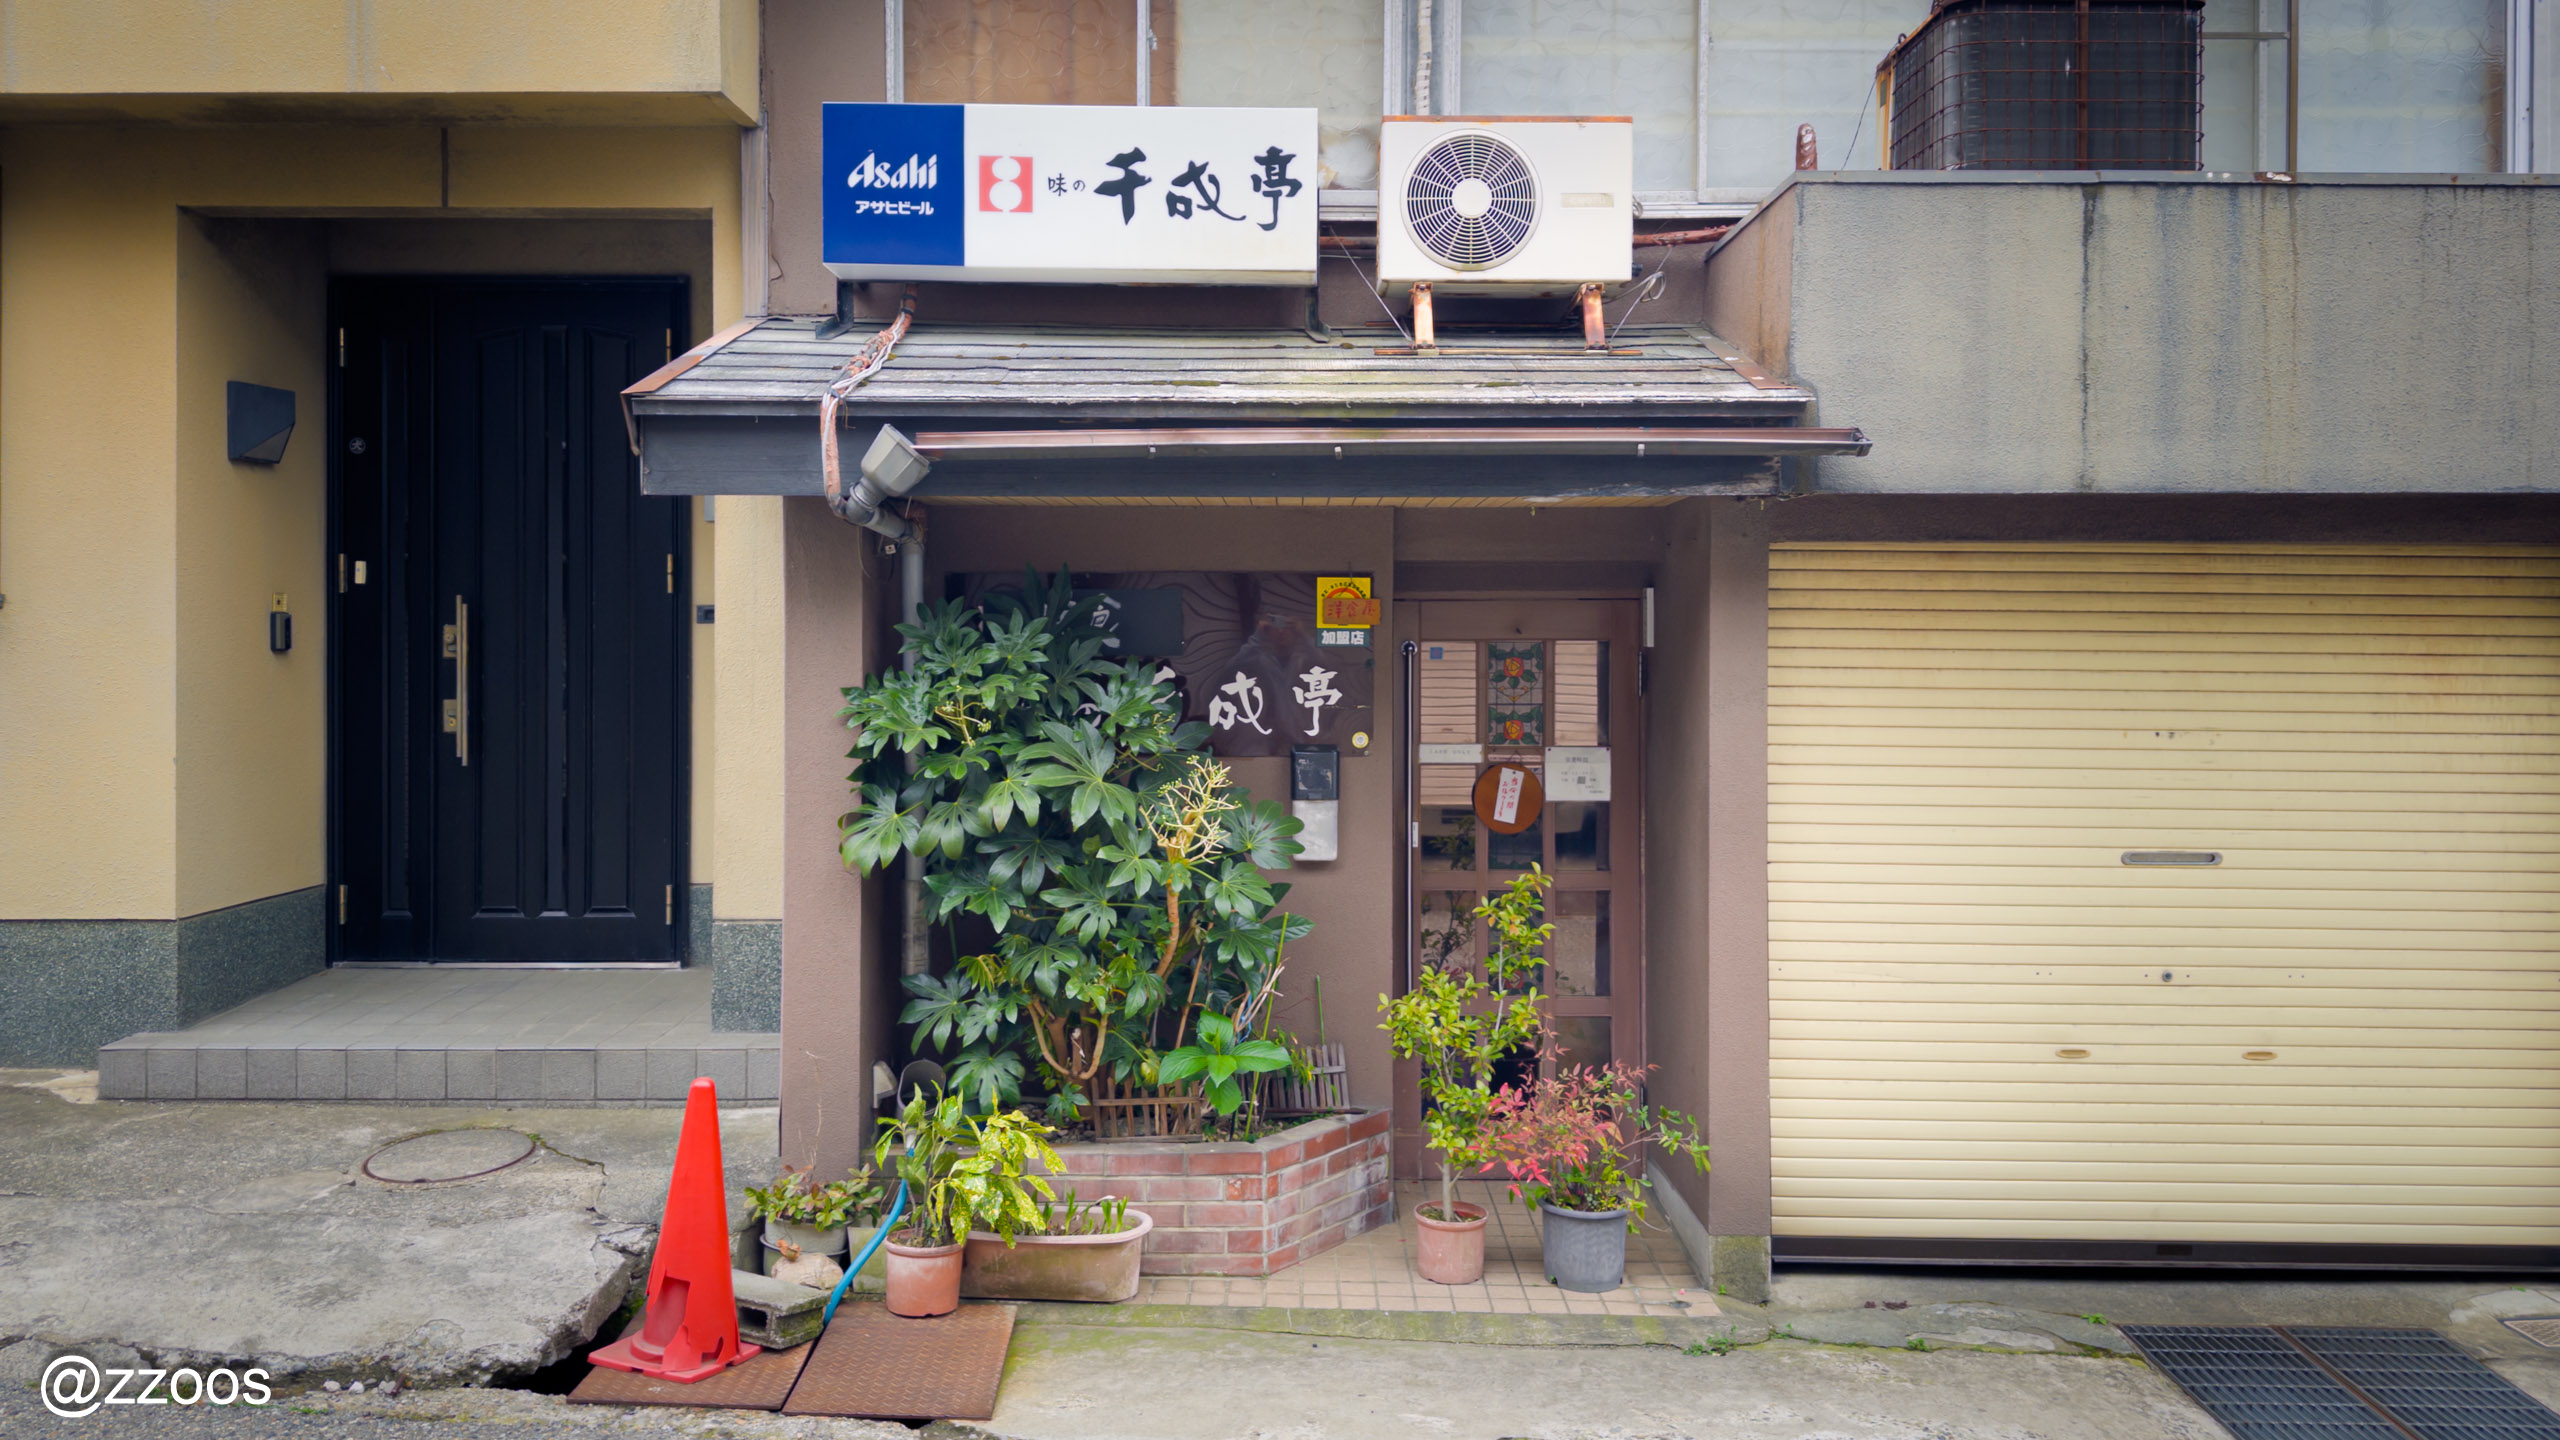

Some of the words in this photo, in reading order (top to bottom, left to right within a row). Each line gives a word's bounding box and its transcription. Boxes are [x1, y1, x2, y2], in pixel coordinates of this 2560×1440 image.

[848, 153, 937, 189] Asahi
[856, 200, 934, 215] アサヒビール
[1321, 630, 1364, 645] 加盟店
